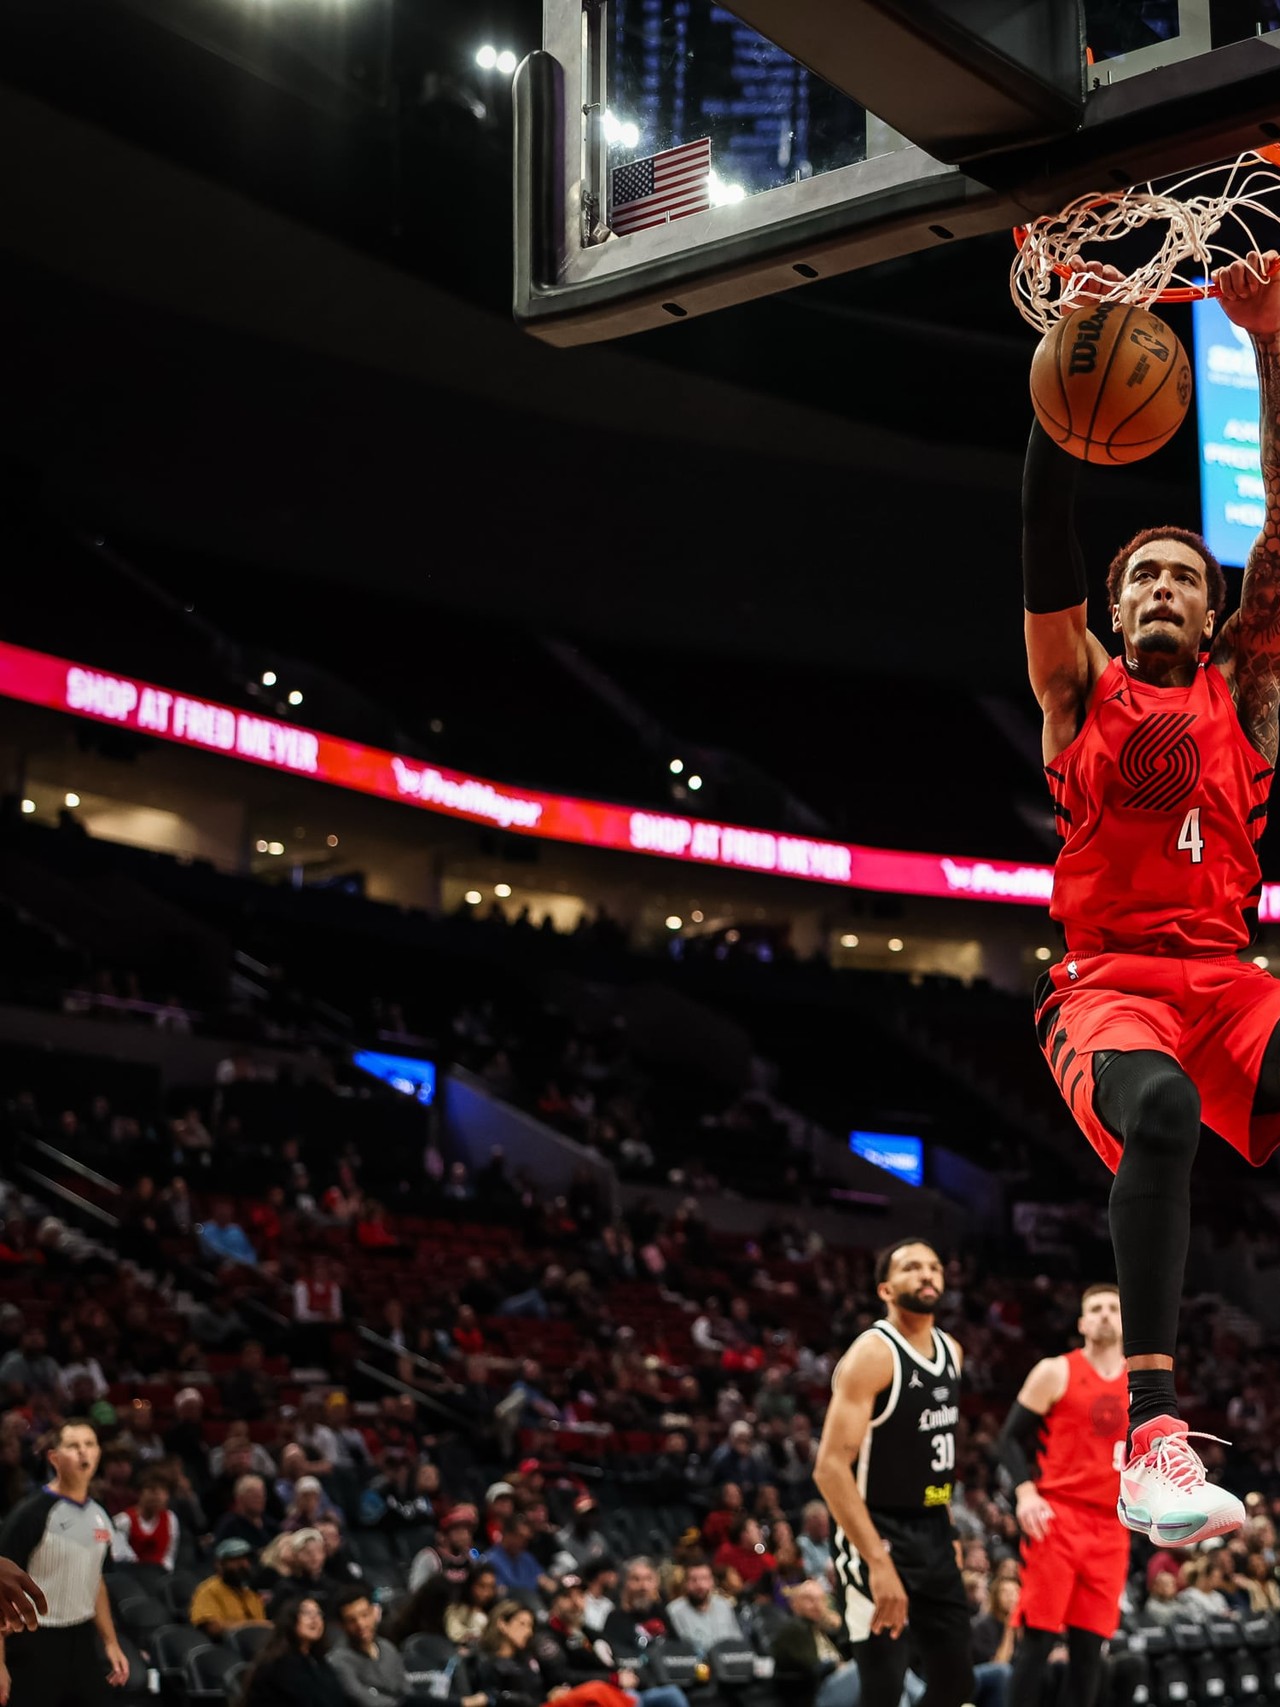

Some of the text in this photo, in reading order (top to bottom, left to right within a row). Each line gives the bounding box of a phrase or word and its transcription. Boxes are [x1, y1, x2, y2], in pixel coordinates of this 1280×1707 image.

[67, 667, 319, 773] SHOP AT FRED MEYER
[630, 812, 851, 881] SHOP AT FRED MEYER
[1177, 807, 1204, 864] 4
[931, 1432, 955, 1472] 31
[925, 1483, 952, 1501] Sail
